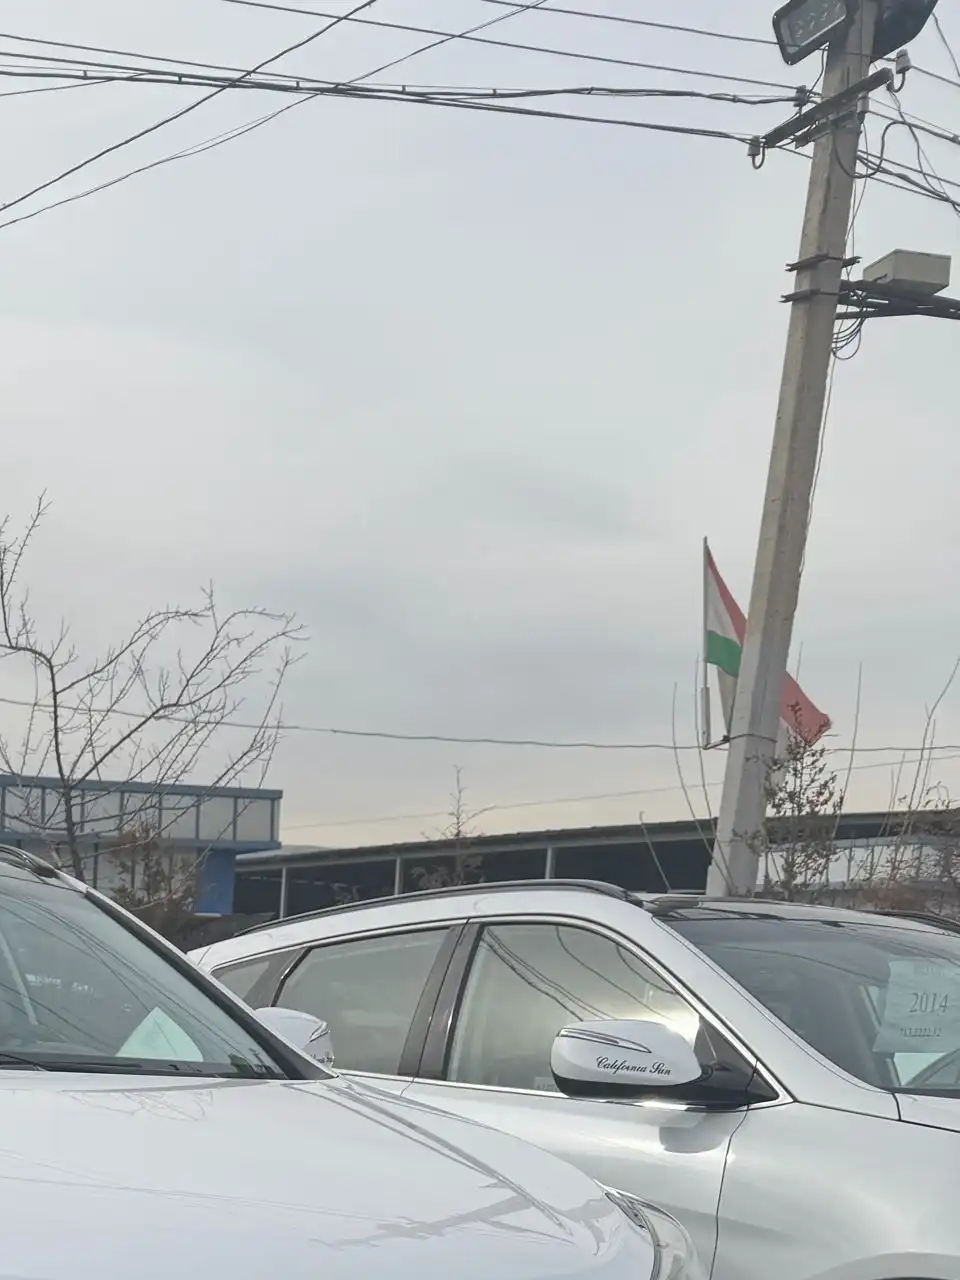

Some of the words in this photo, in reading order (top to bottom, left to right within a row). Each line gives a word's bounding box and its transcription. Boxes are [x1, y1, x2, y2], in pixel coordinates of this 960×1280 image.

[908, 991, 949, 1013] 2014
[596, 1056, 647, 1075] California
[649, 1061, 672, 1075] Sun
